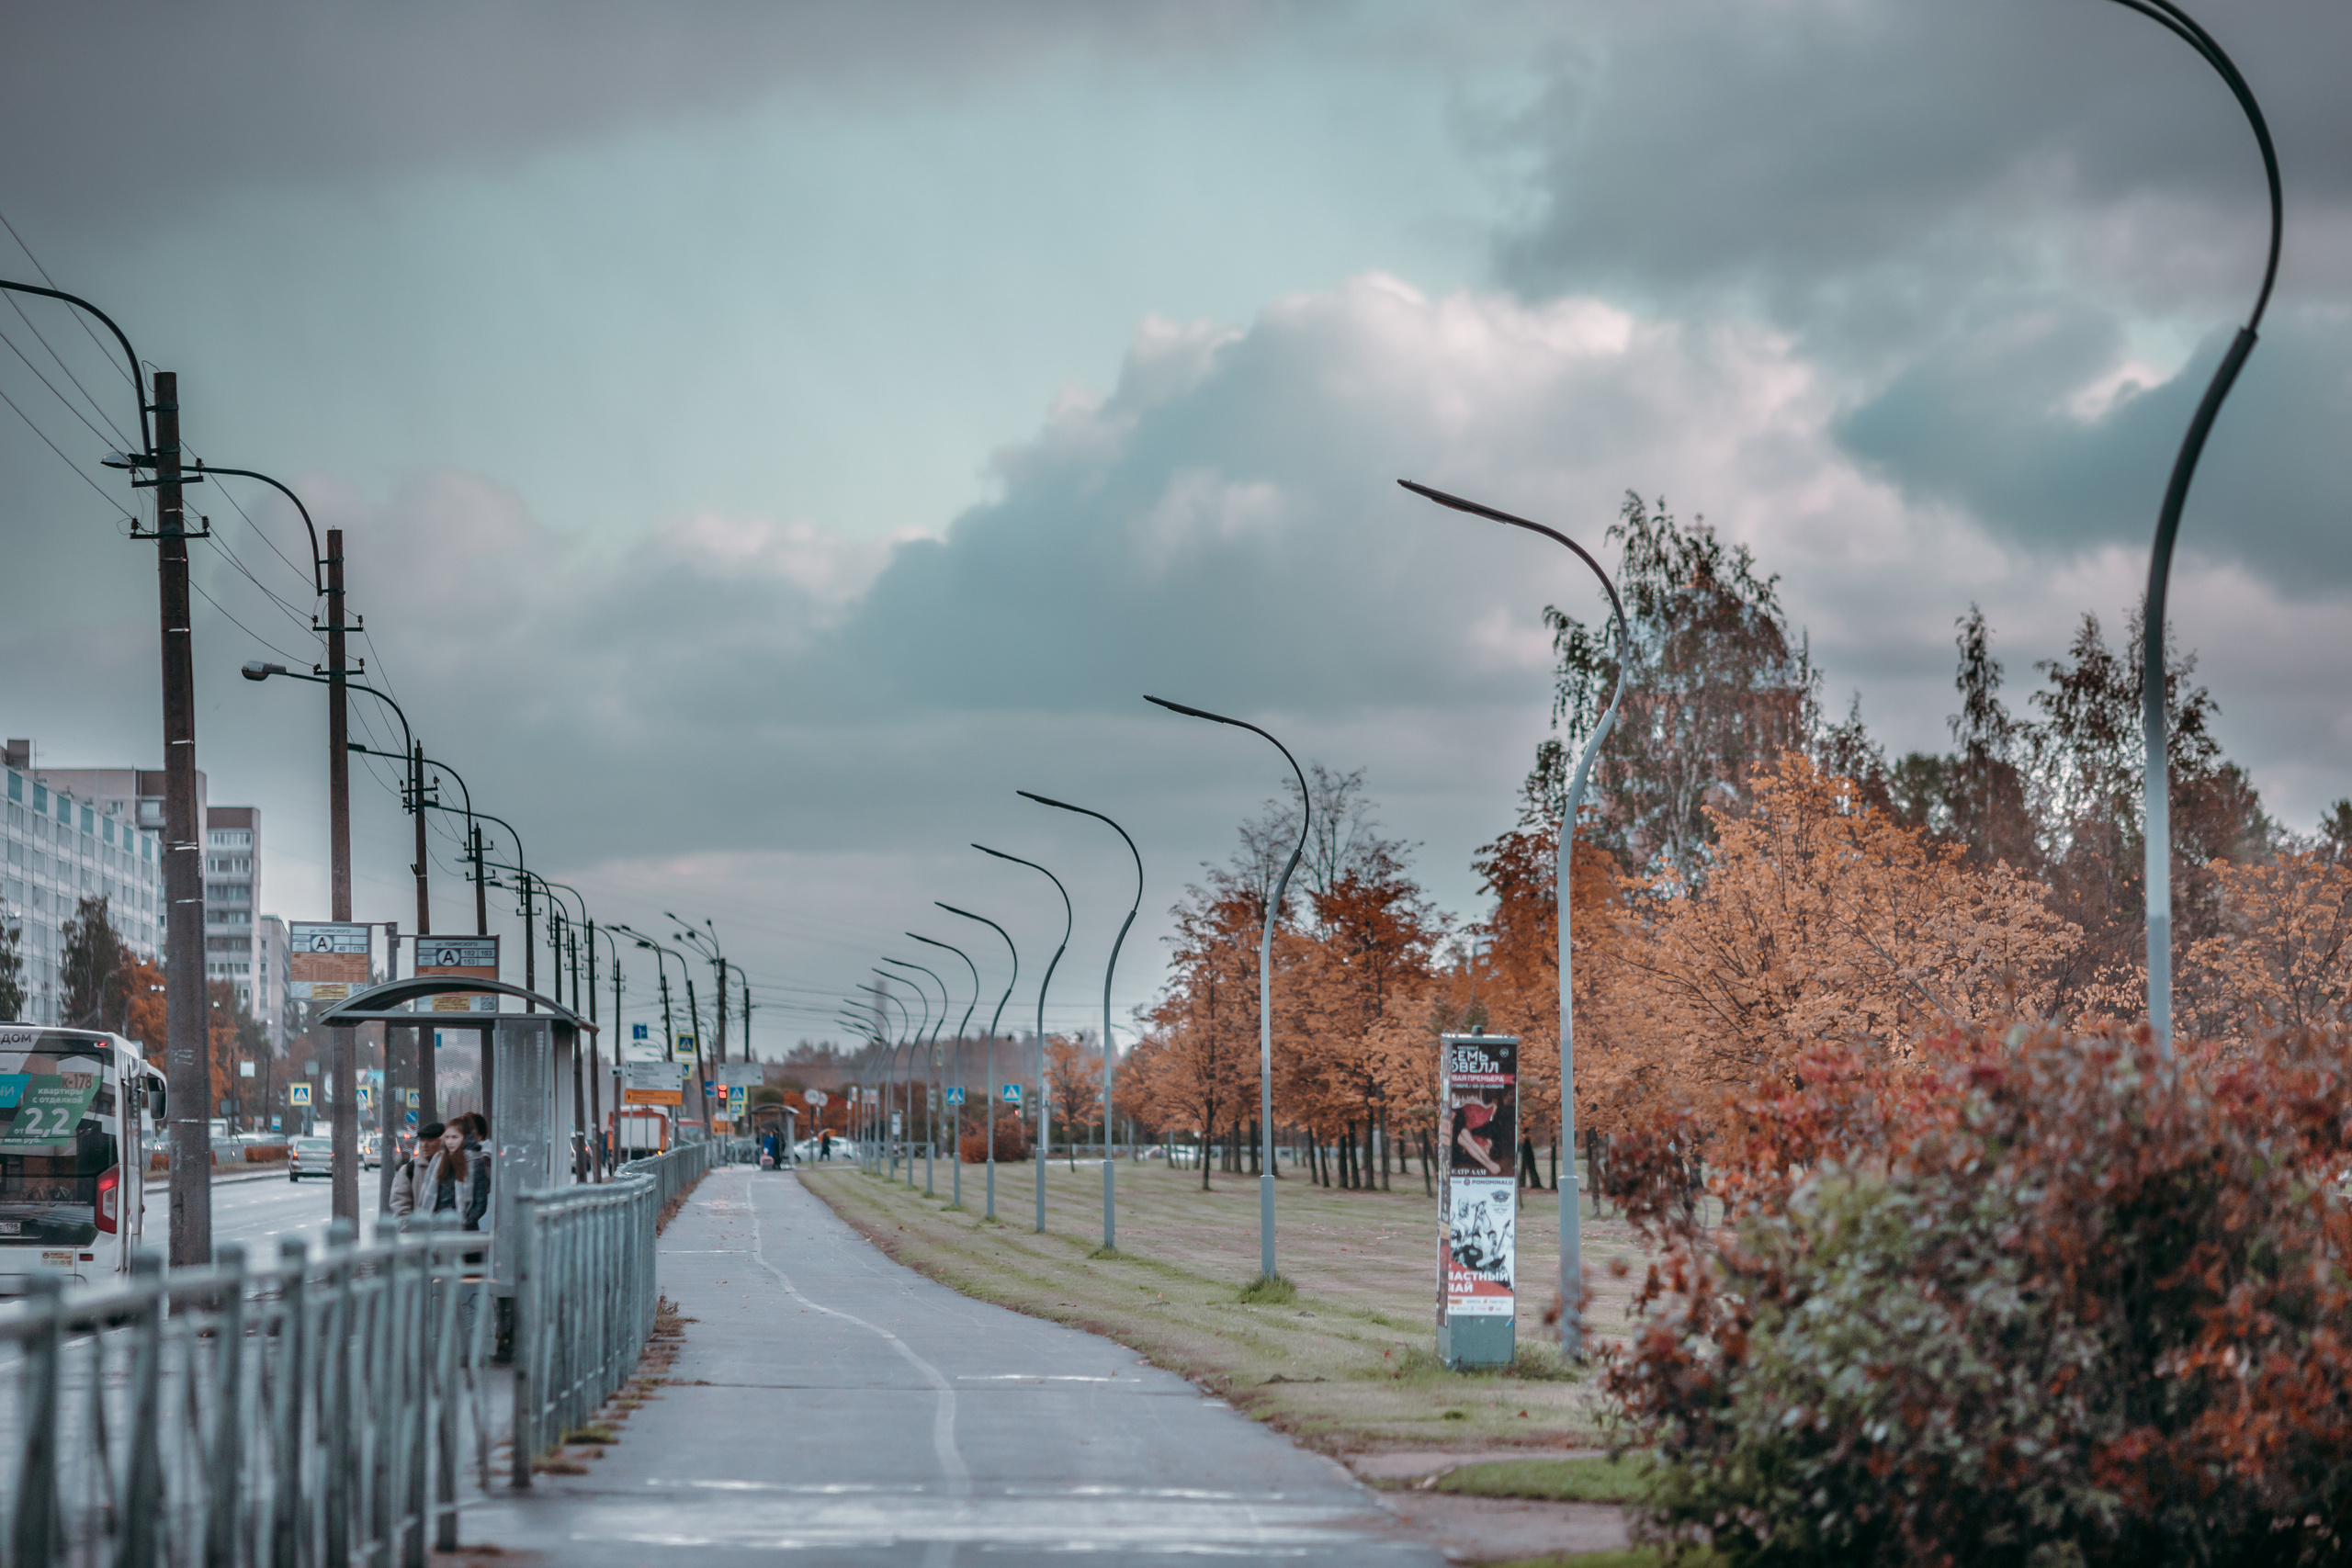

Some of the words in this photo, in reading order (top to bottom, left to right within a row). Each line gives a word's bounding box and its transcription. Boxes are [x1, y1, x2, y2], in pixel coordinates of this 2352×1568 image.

[1, 1033, 32, 1044] ДОМ
[38, 1089, 84, 1097] квартиры
[39, 1096, 84, 1104] отделкой
[25, 1108, 70, 1138] 2,2
